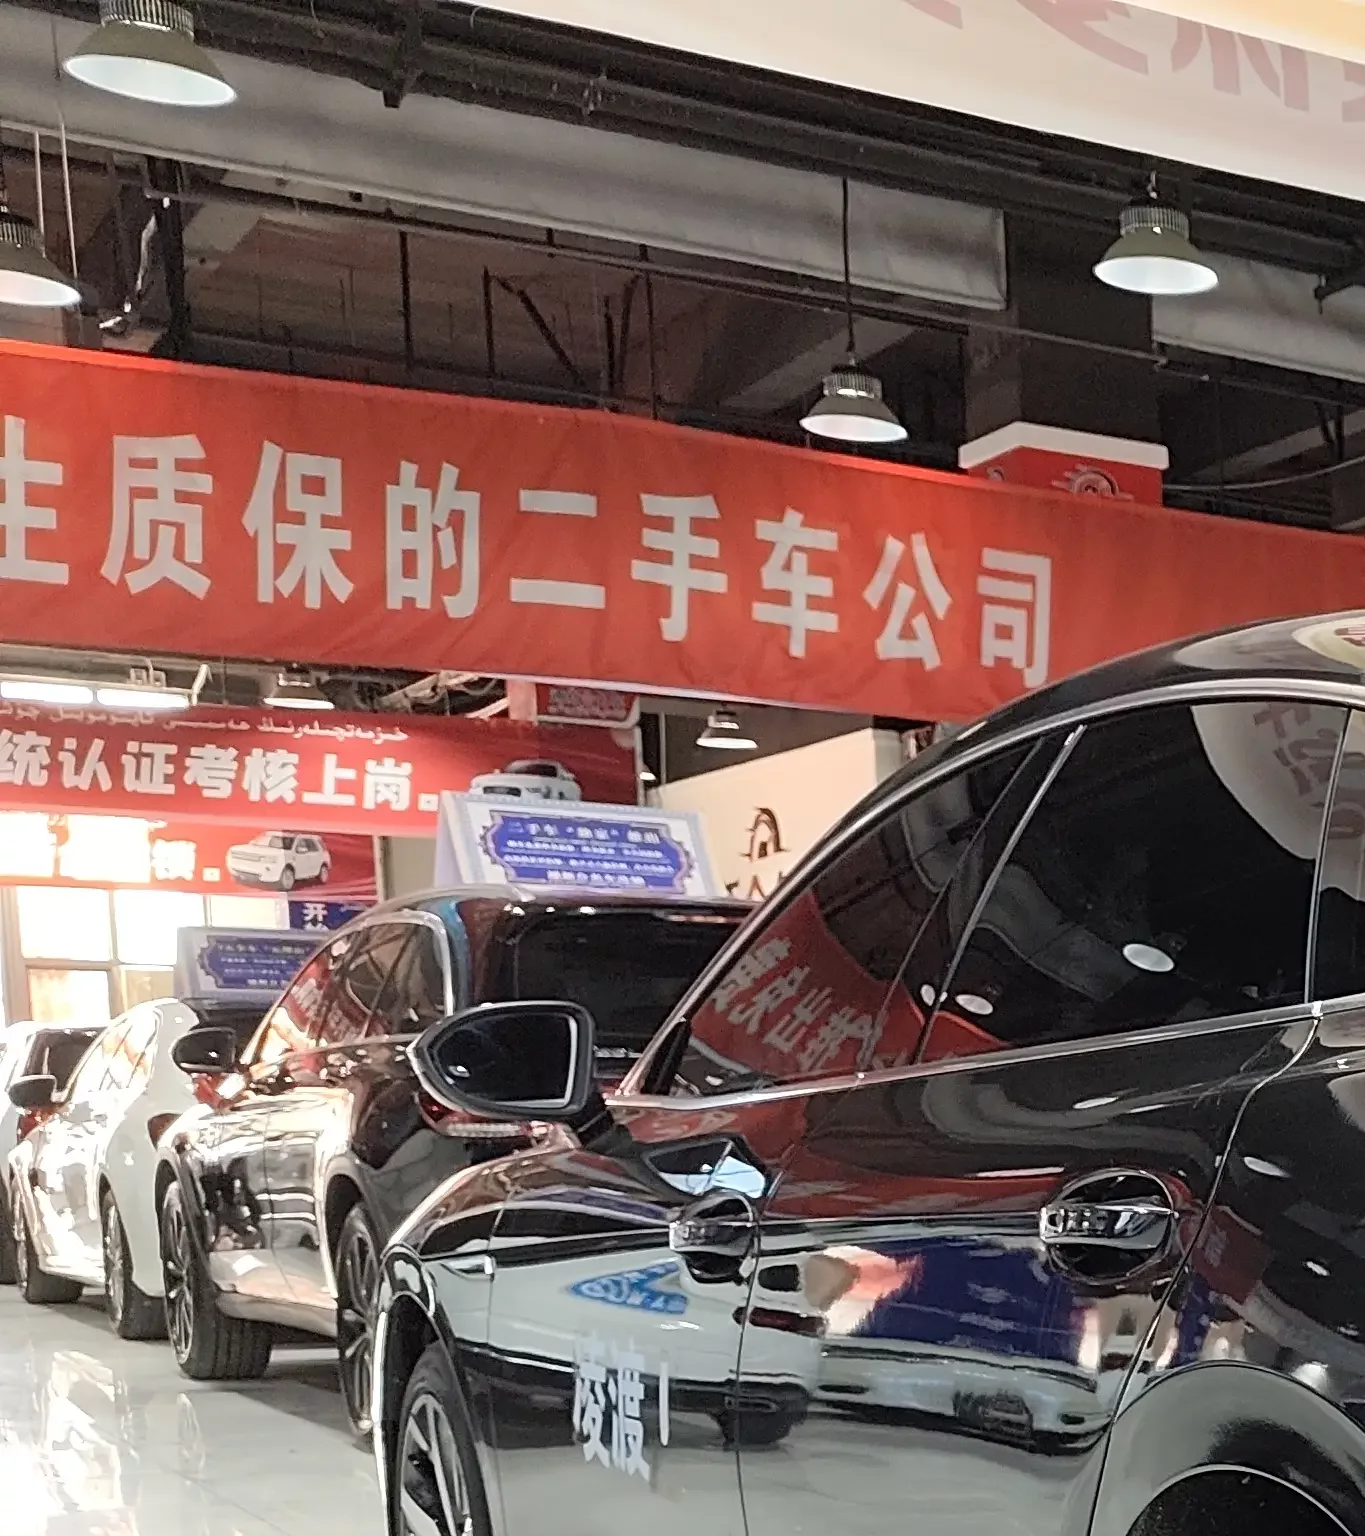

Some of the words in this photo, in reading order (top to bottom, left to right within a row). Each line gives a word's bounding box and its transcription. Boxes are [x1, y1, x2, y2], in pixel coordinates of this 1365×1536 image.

[0, 727, 439, 813] 统认证考核上岗。
